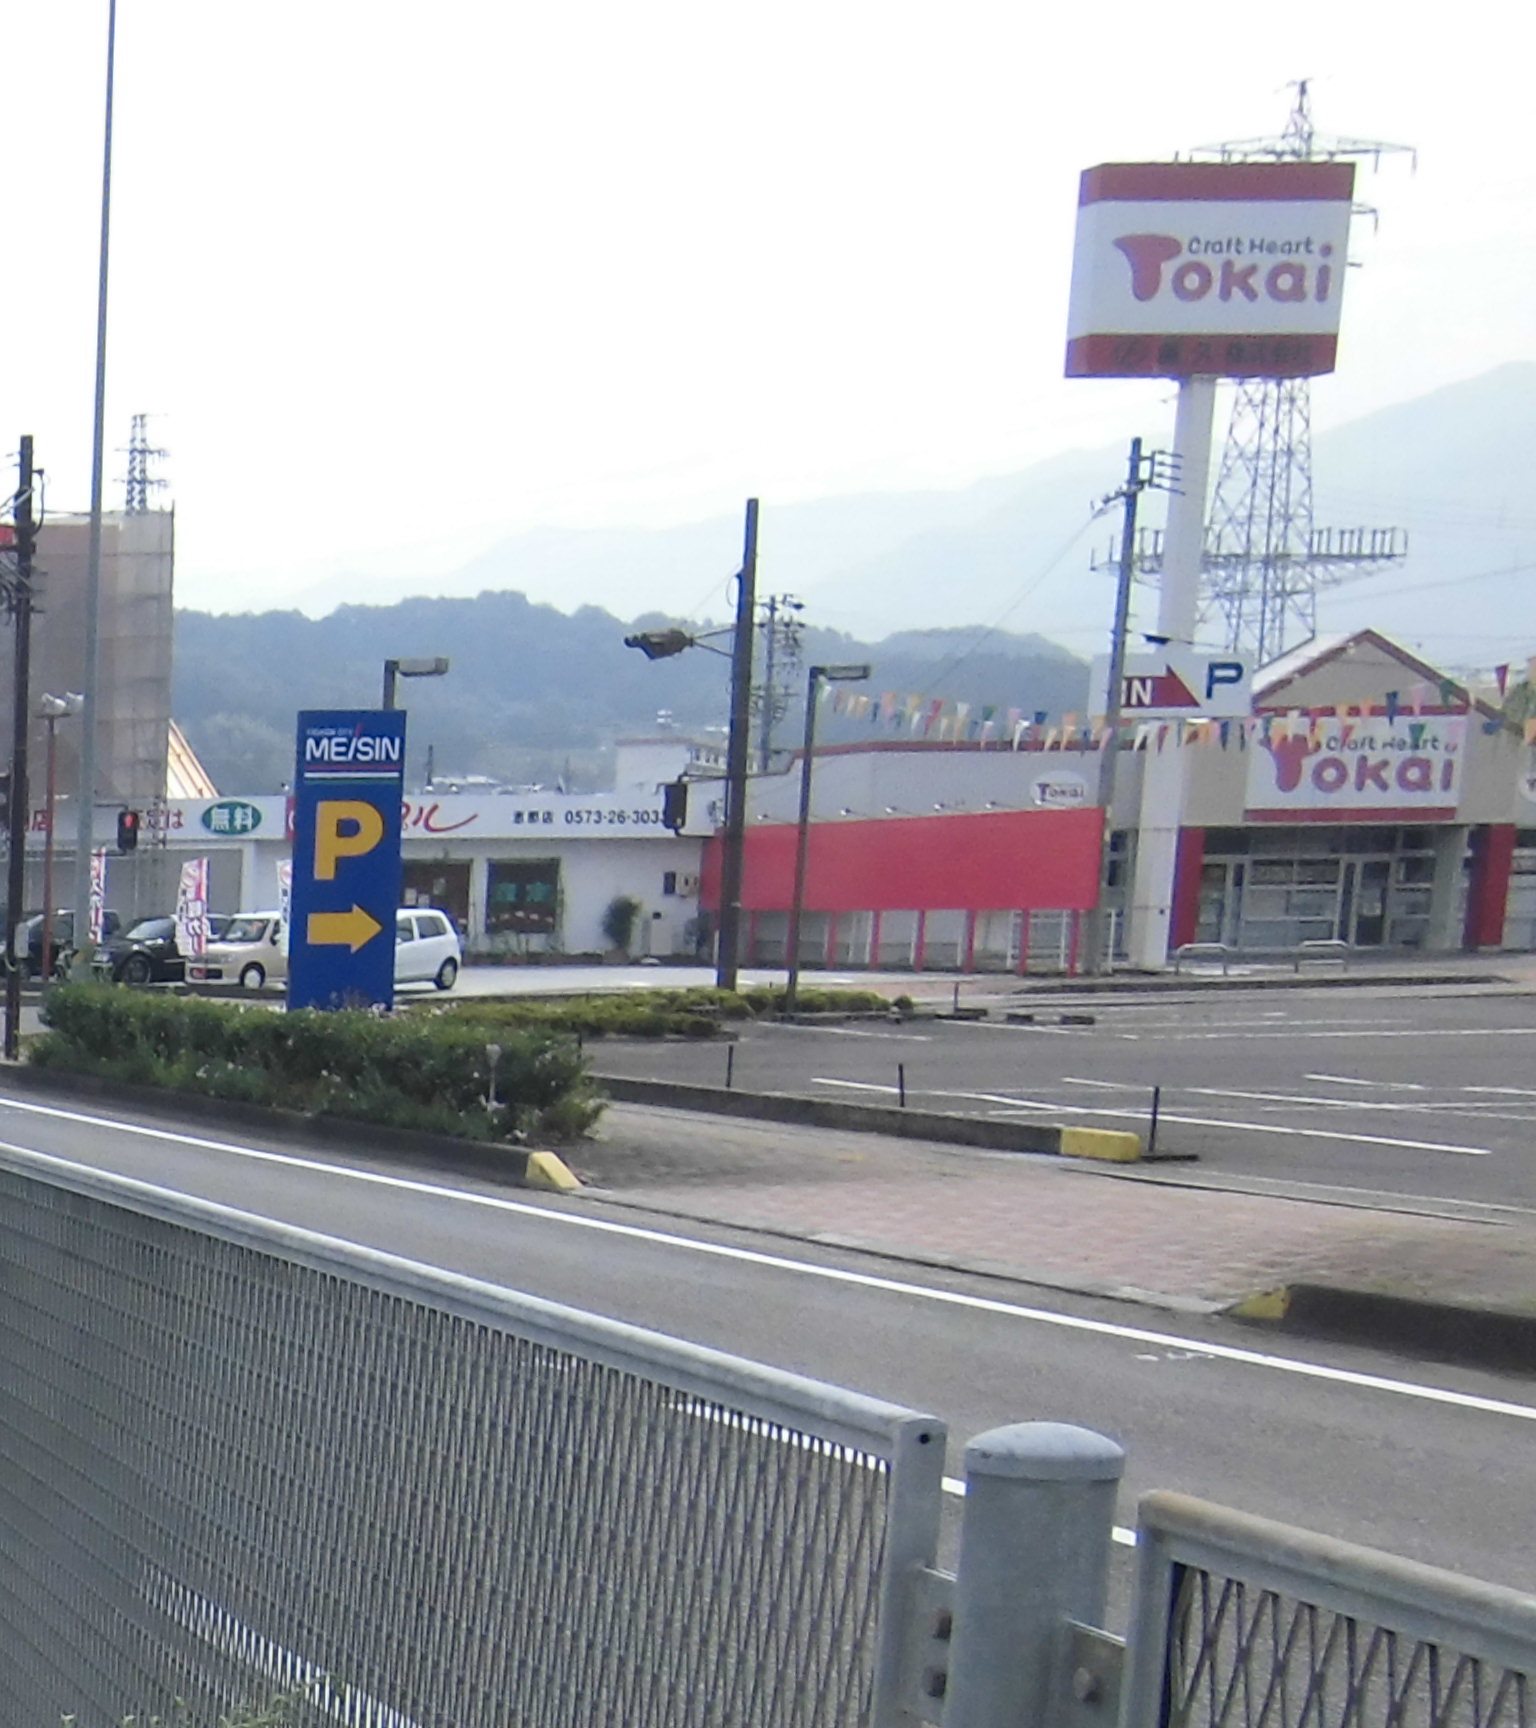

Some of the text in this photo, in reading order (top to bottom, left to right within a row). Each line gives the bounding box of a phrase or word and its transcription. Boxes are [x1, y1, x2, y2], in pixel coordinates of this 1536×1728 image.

[1187, 237, 1314, 255] Craft Heart
[1112, 234, 1333, 302] Tokai
[1120, 678, 1152, 706] IN
[1206, 663, 1243, 699] P
[209, 805, 256, 831] 無料
[314, 801, 383, 880] P
